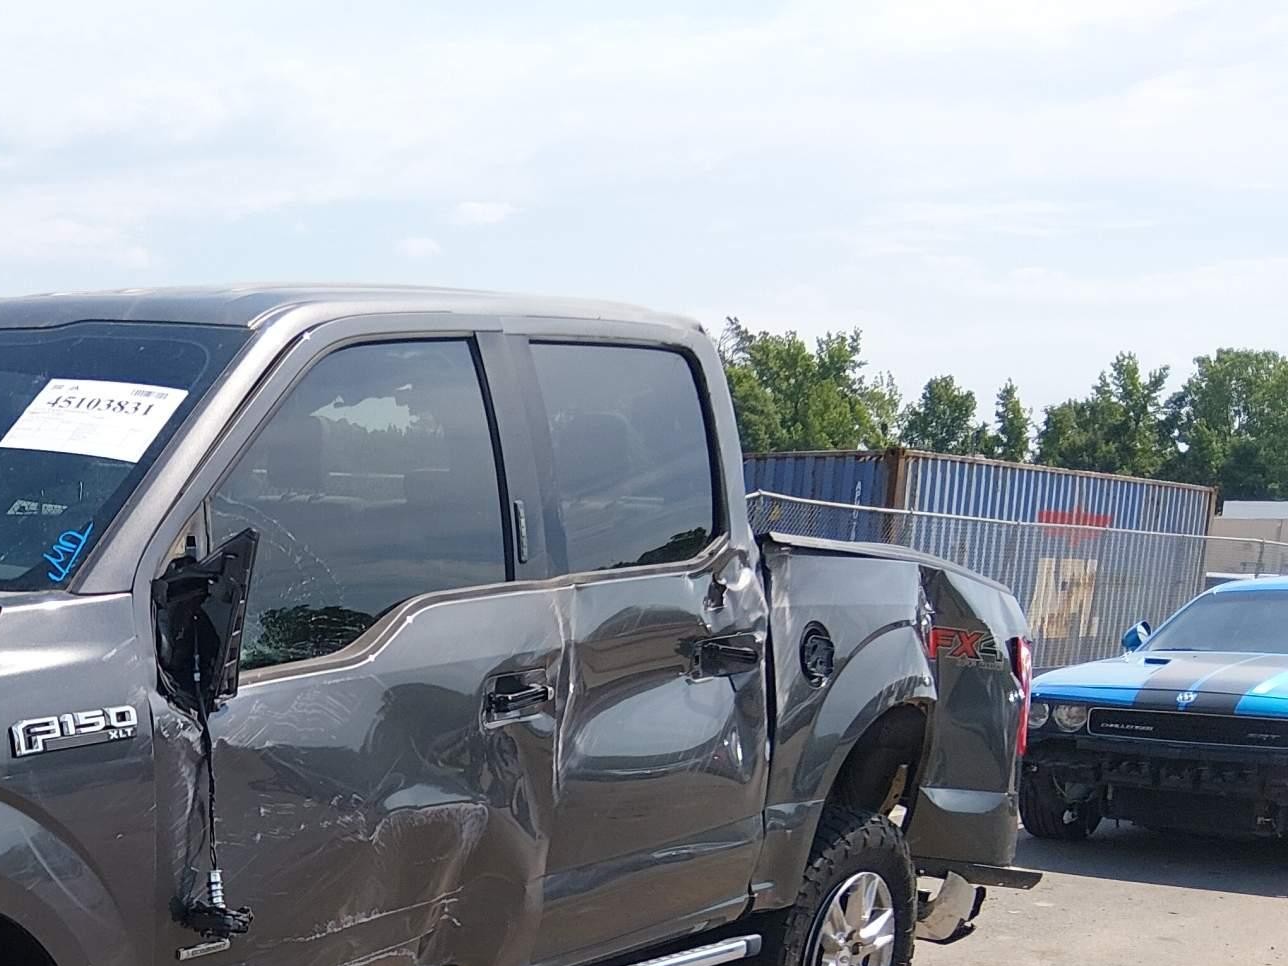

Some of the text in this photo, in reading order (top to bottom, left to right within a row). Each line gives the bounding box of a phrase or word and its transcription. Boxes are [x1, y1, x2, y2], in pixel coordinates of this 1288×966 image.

[47, 395, 155, 416] 45103831
[928, 625, 1004, 663] FX4
[9, 705, 138, 757] F150
[109, 727, 134, 740] XLT
